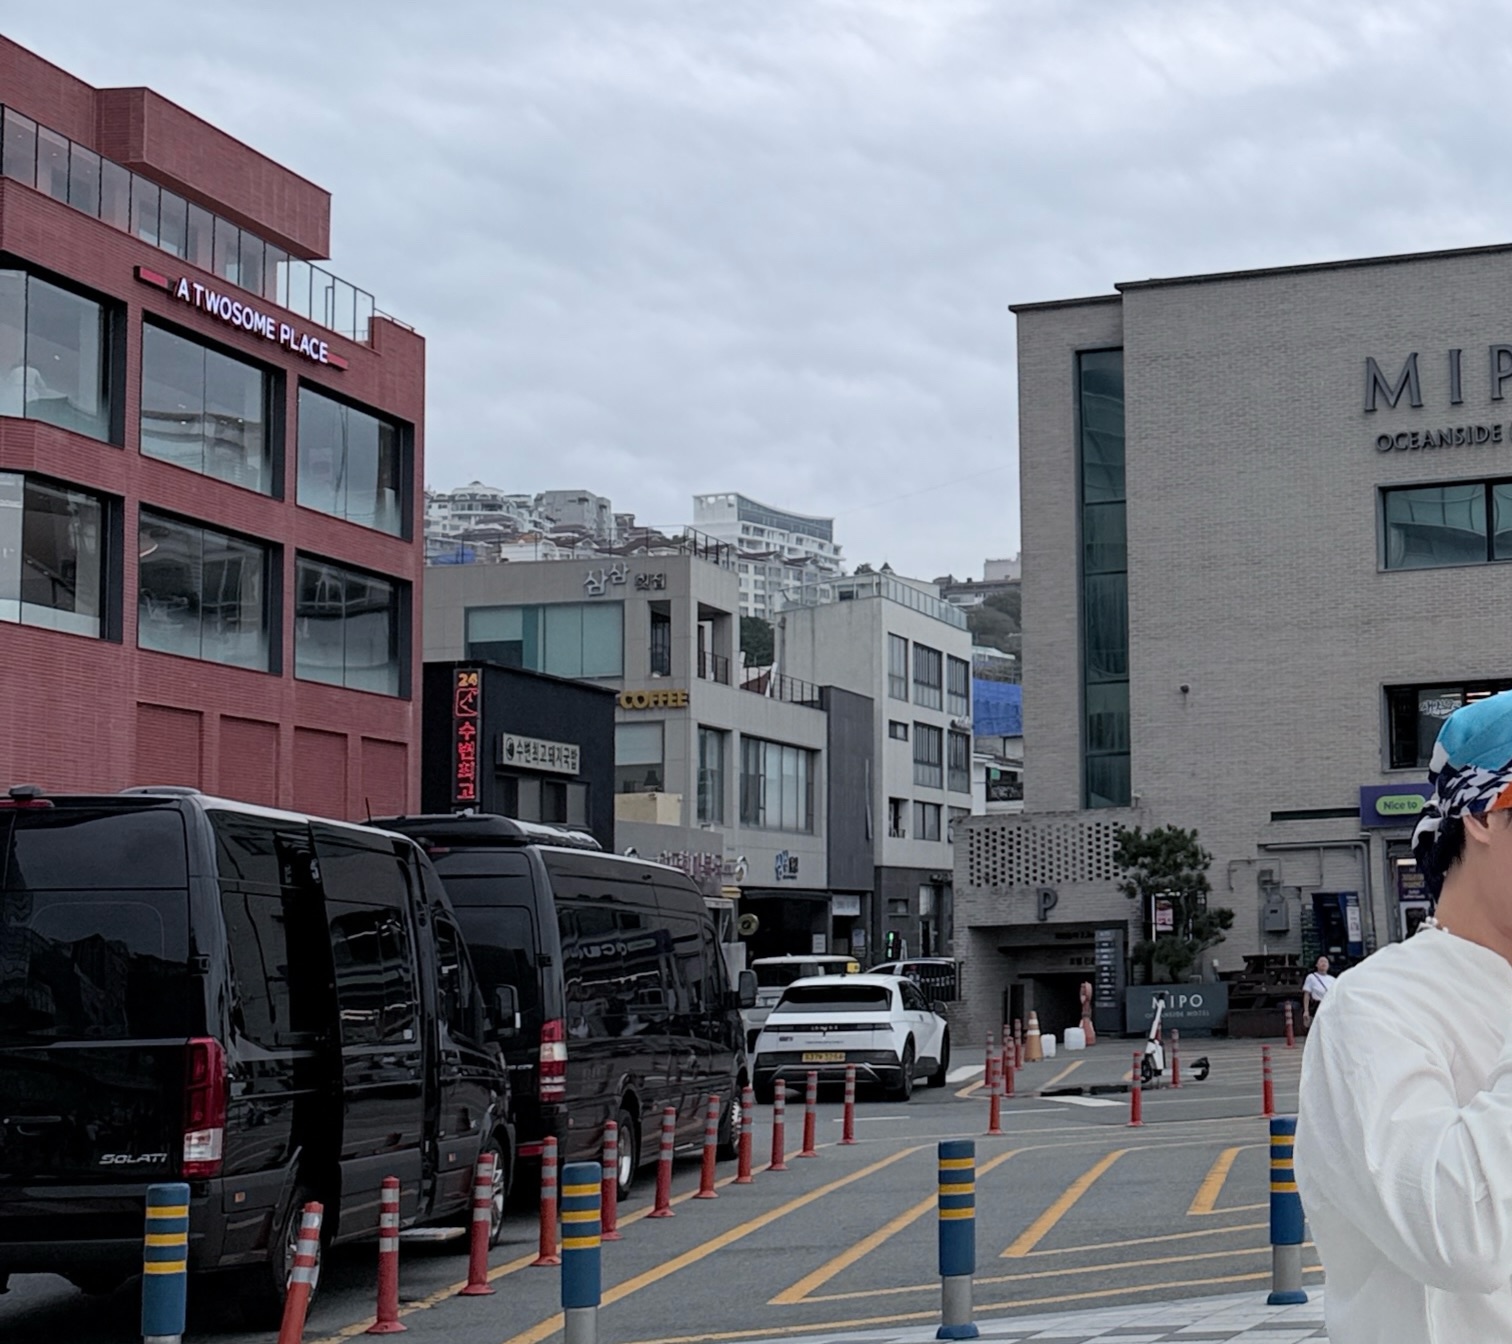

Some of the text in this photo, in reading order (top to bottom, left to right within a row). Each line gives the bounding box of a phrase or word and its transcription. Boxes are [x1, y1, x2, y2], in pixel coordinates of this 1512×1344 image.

[176, 277, 329, 363] A TWOSOME PLACE
[1375, 423, 1503, 452] OCEANSIDE
[583, 562, 630, 597] 삼삼
[458, 672, 478, 687] 24
[619, 689, 689, 709] COFFEE
[456, 721, 476, 800] 수변최고
[1383, 800, 1418, 810] Nice to
[1036, 887, 1058, 922] P
[1152, 993, 1203, 1010] MIPO
[99, 1153, 167, 1165] SOLATI
